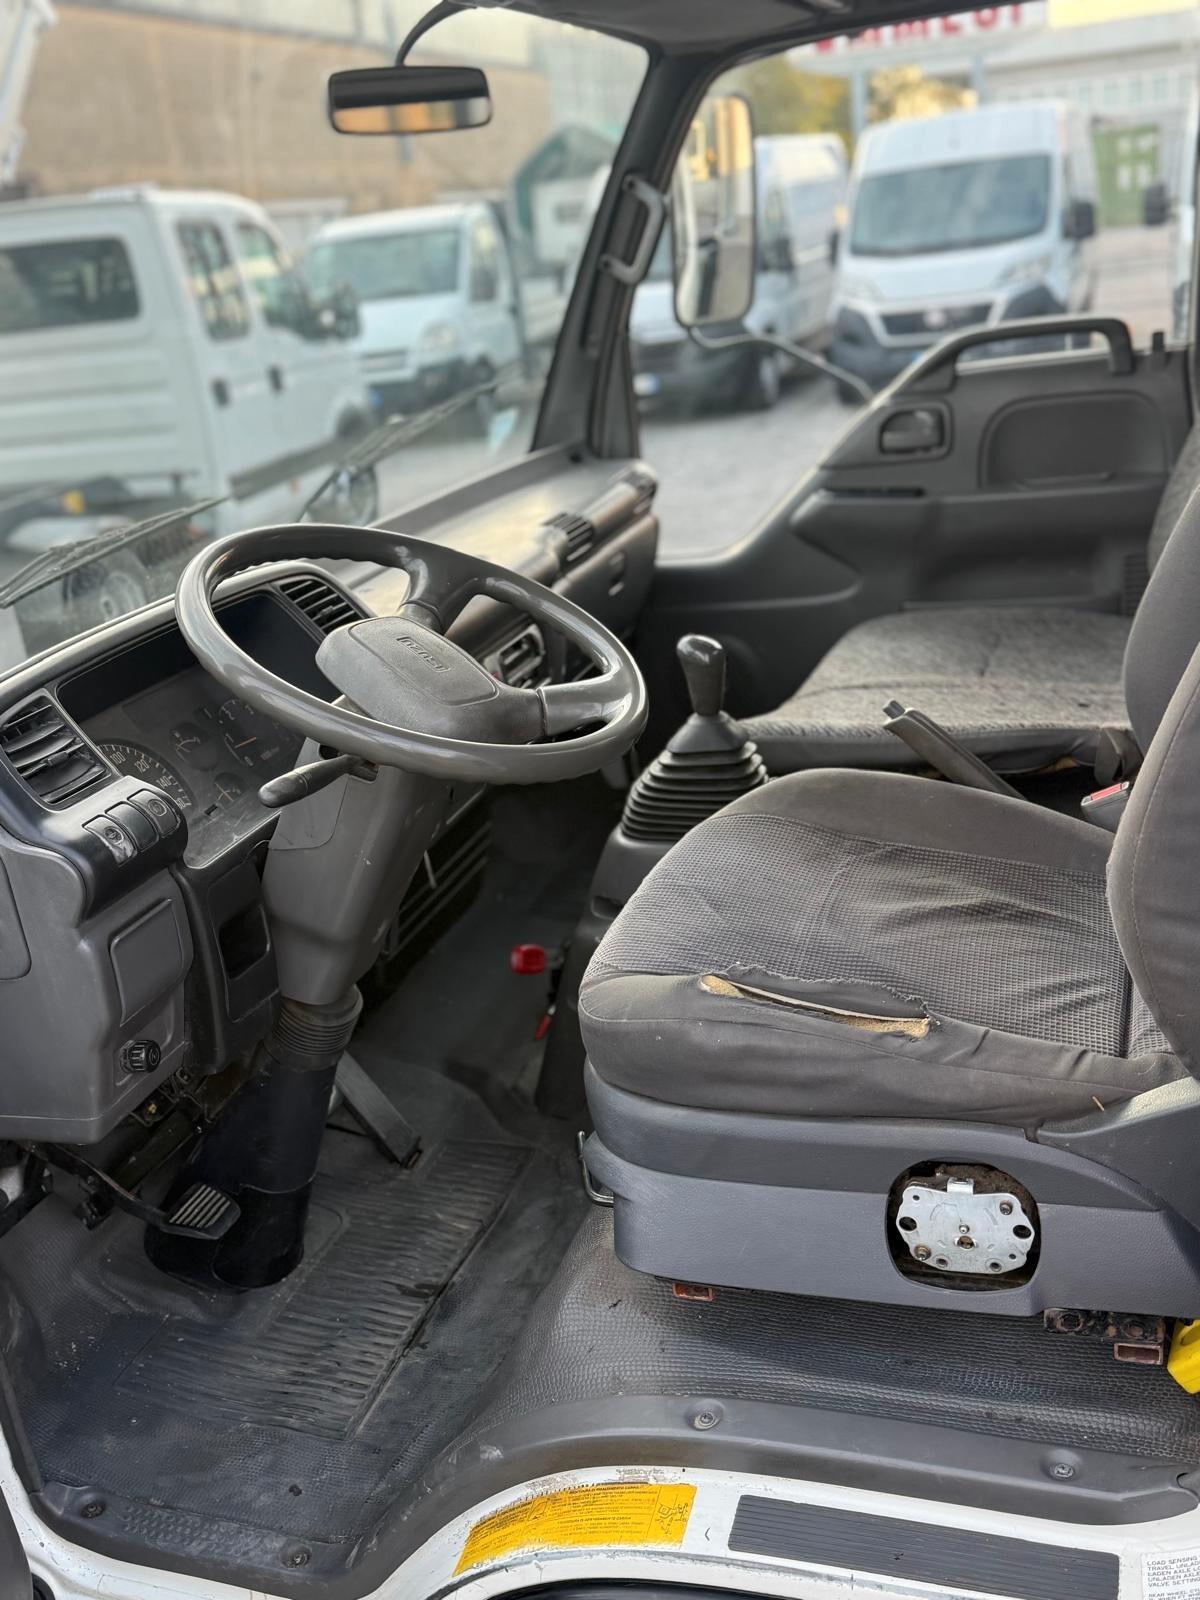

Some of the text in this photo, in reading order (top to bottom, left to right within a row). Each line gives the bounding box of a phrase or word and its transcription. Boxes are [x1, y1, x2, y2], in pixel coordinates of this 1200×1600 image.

[110, 751, 126, 765] 100
[134, 758, 150, 773] 120
[156, 775, 172, 789] 140
[1168, 1556, 1197, 1564] SENSING
